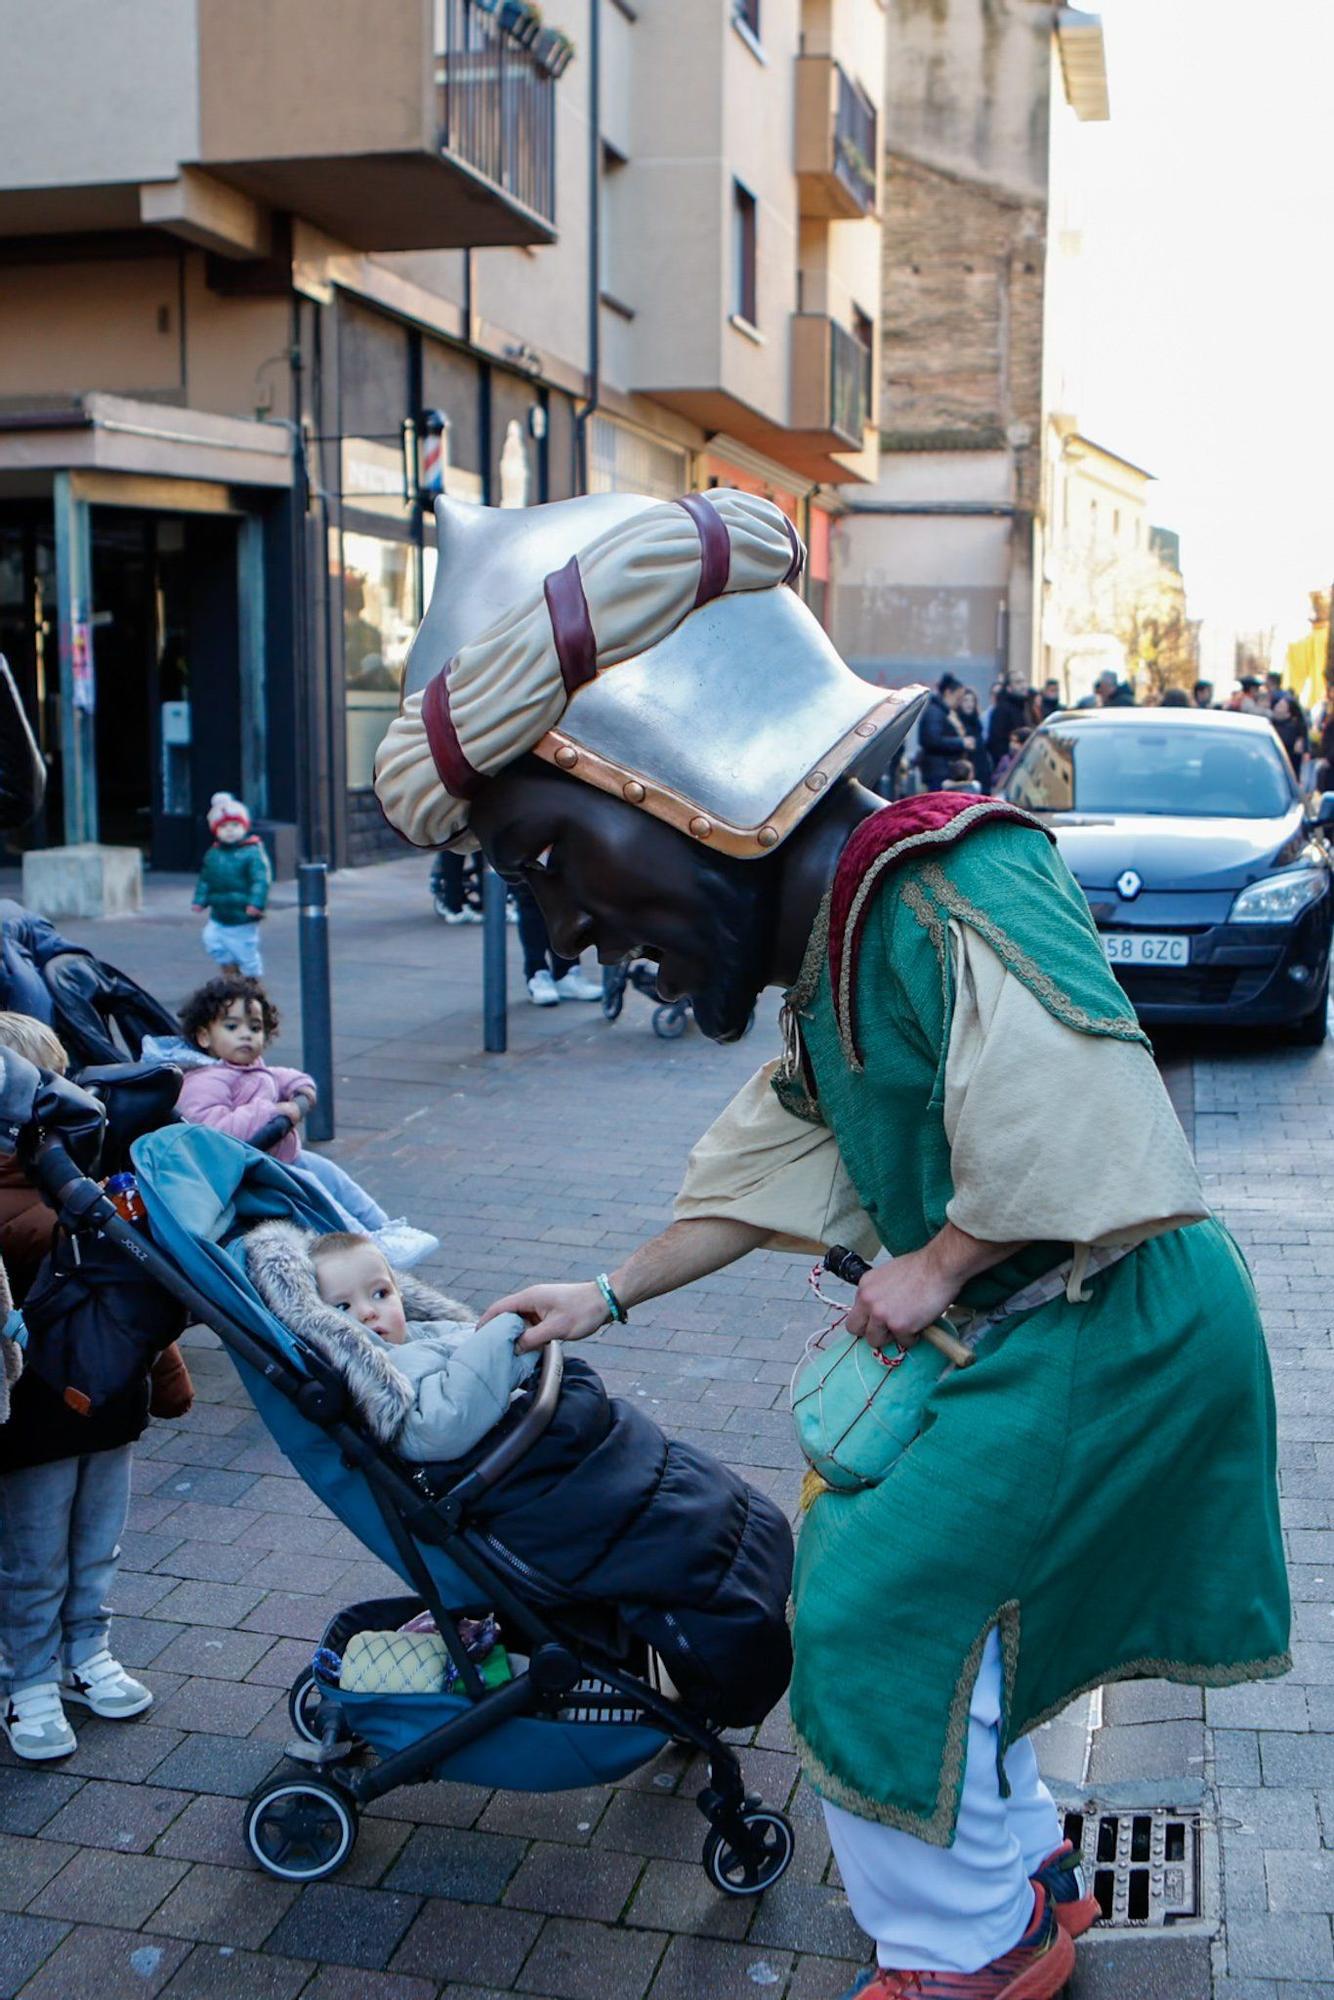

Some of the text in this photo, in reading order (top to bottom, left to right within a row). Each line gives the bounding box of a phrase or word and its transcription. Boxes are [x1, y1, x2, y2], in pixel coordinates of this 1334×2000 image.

[1105, 938, 1182, 961] 58 GZC
[120, 1238, 148, 1261] JOOLZ
